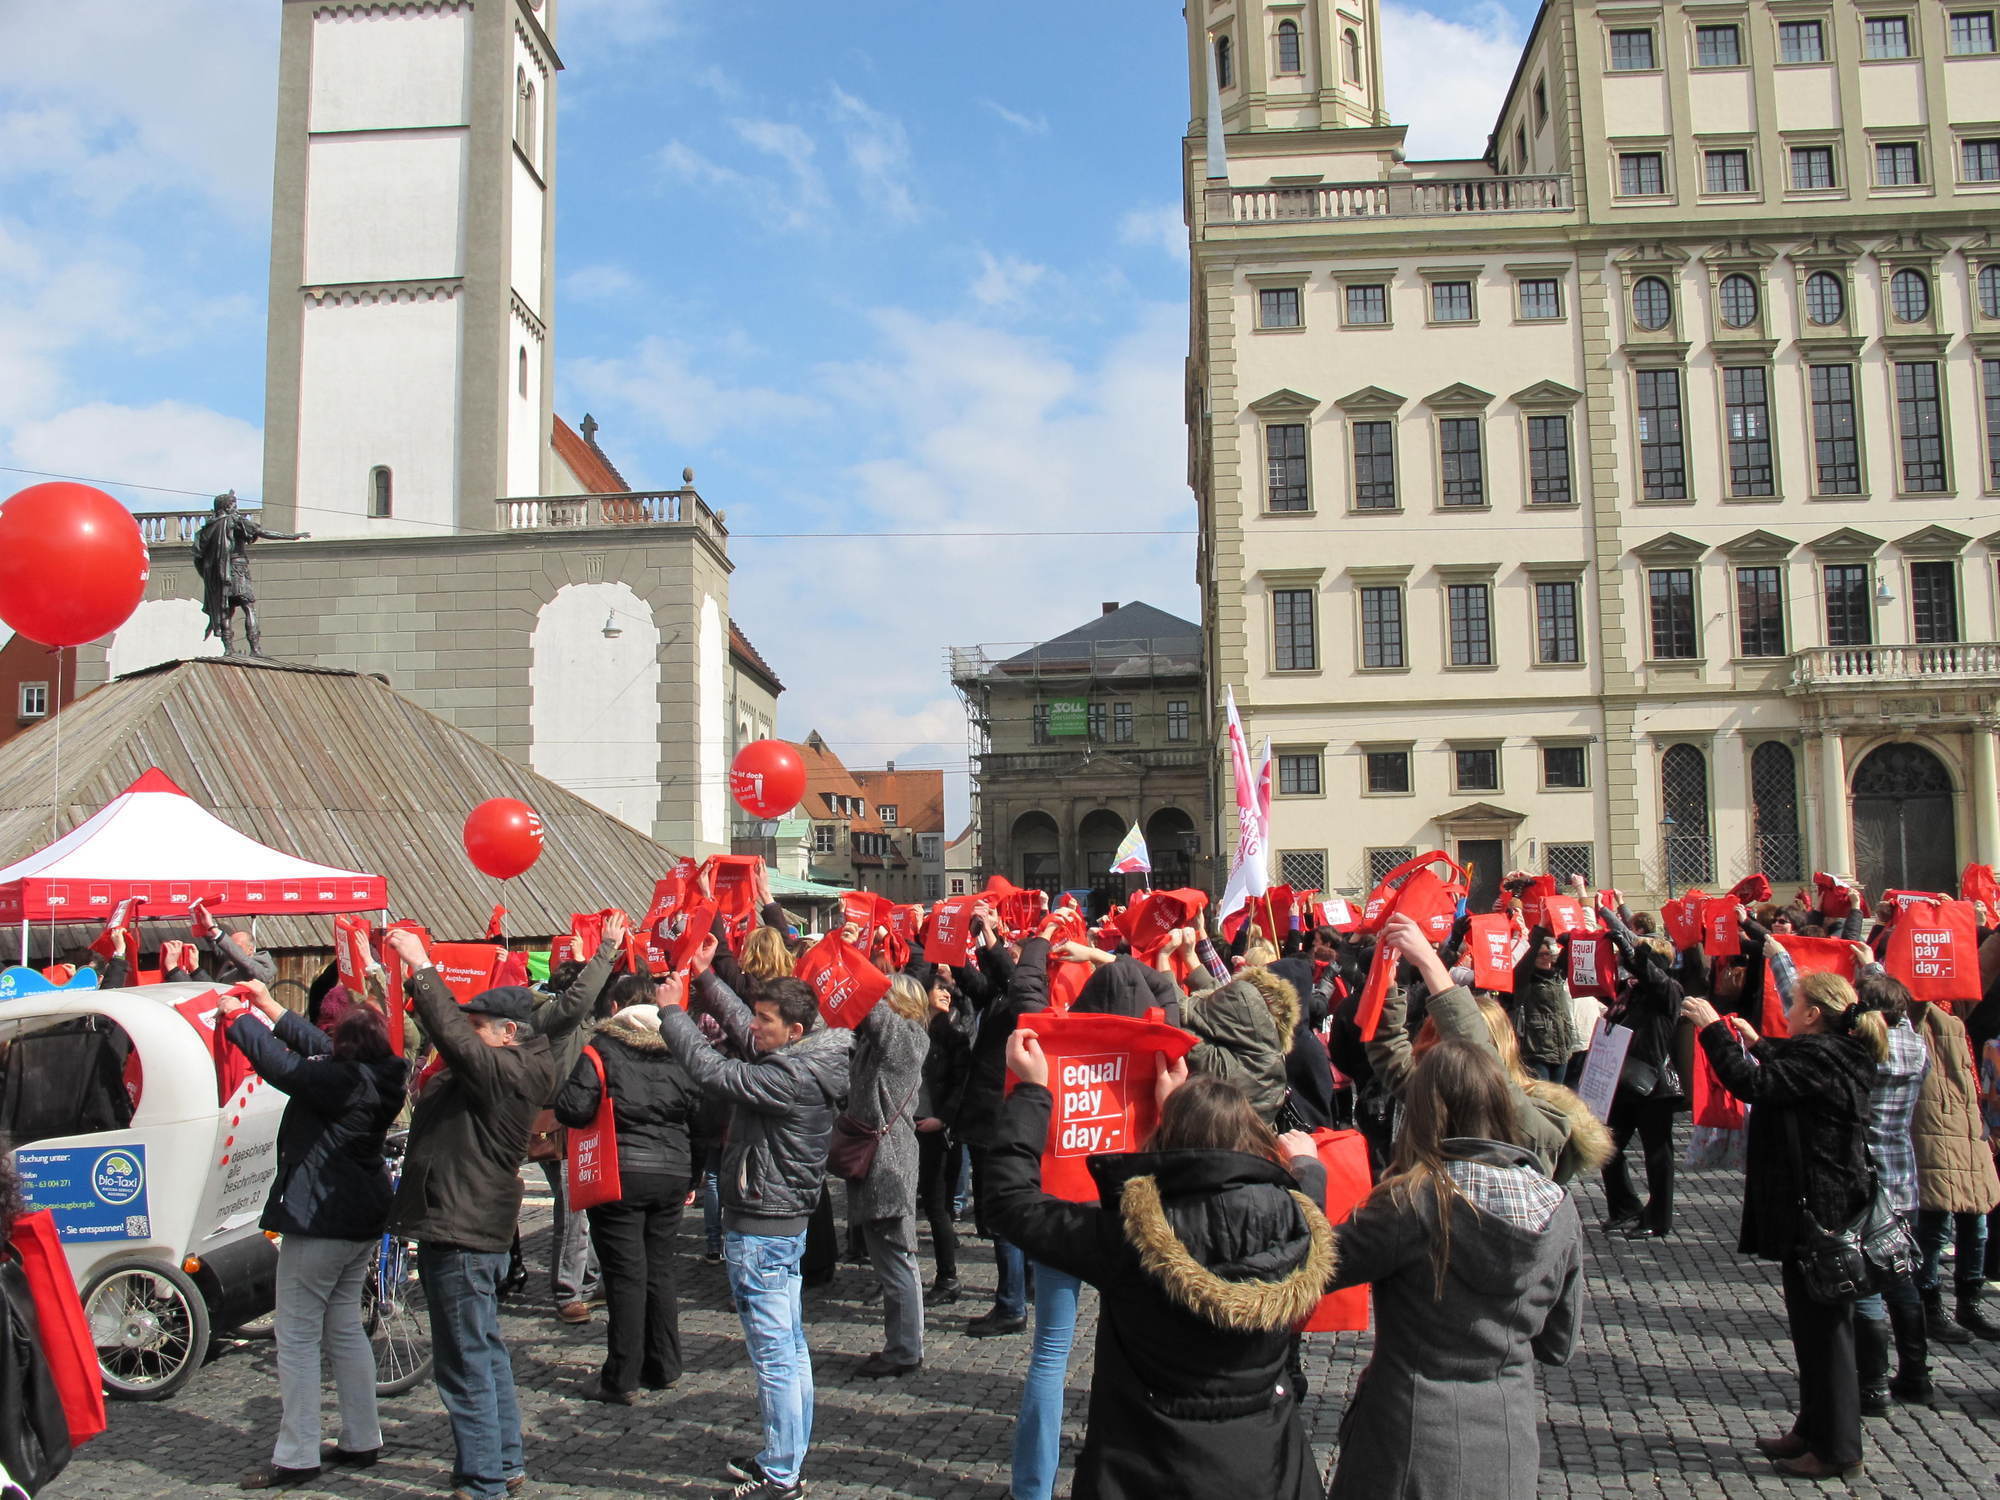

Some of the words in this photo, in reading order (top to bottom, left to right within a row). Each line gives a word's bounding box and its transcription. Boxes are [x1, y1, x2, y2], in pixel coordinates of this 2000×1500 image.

[746, 771, 763, 779] doch
[91, 896, 108, 904] SPD
[171, 894, 188, 902] SPD
[283, 892, 299, 900] SPD
[318, 892, 334, 900] SPD
[352, 891, 367, 899] SPD
[48, 897, 66, 905] SPD
[1914, 931, 1951, 946] equal
[1573, 942, 1594, 954] equal
[1915, 946, 1939, 958] pay
[445, 976, 472, 984] Augsburg
[1063, 1056, 1123, 1089] equal
[1064, 1089, 1102, 1119] pay
[579, 1134, 599, 1153] equal
[20, 1155, 48, 1164] Buchung
[578, 1151, 593, 1166] pay
[98, 1175, 138, 1188] Bio-Taxi
[66, 1225, 78, 1234] Sie
[80, 1223, 124, 1235] entspannen!
